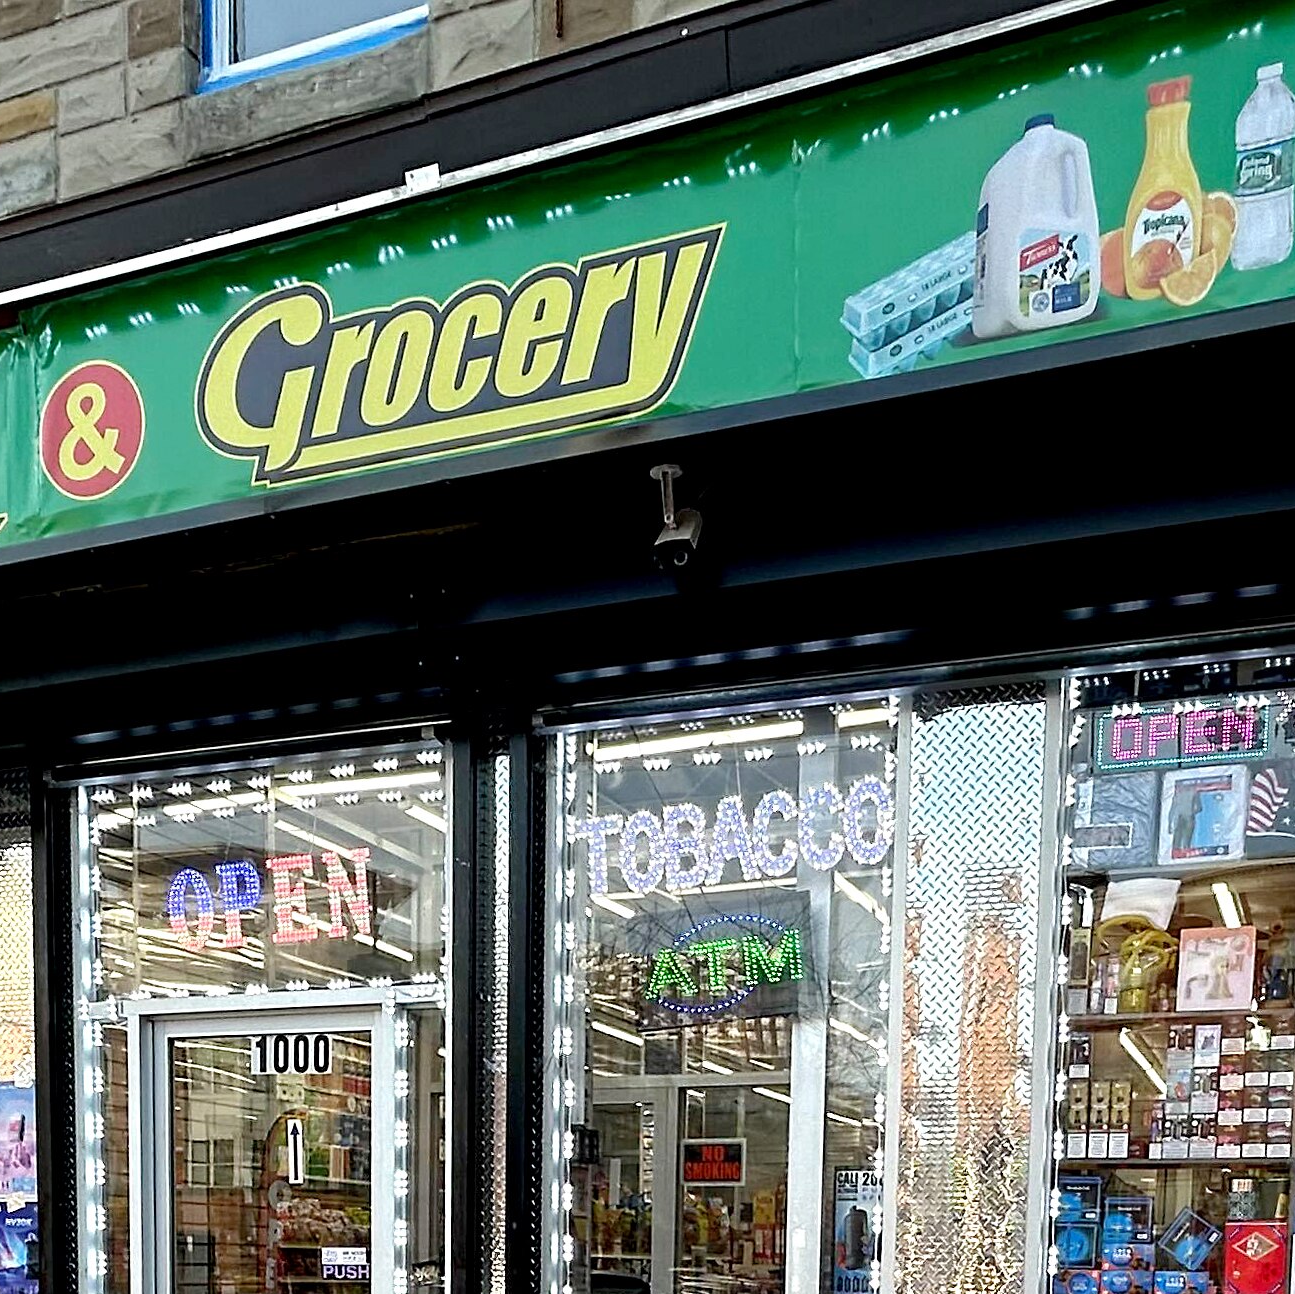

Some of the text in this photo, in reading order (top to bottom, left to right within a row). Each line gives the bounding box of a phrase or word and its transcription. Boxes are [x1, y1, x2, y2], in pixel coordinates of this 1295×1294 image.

[1143, 211, 1186, 235] Tropicana
[57, 382, 127, 484] &
[197, 222, 727, 487] Grocery
[1110, 706, 1257, 761] OPEN
[568, 775, 896, 895] TOBACCO
[167, 846, 373, 955] OPEN
[645, 928, 805, 1001] ATM
[255, 1034, 330, 1074] 1000
[684, 1161, 741, 1182] SMOKING
[701, 1145, 725, 1162] NO
[322, 1265, 370, 1279] PUSH
